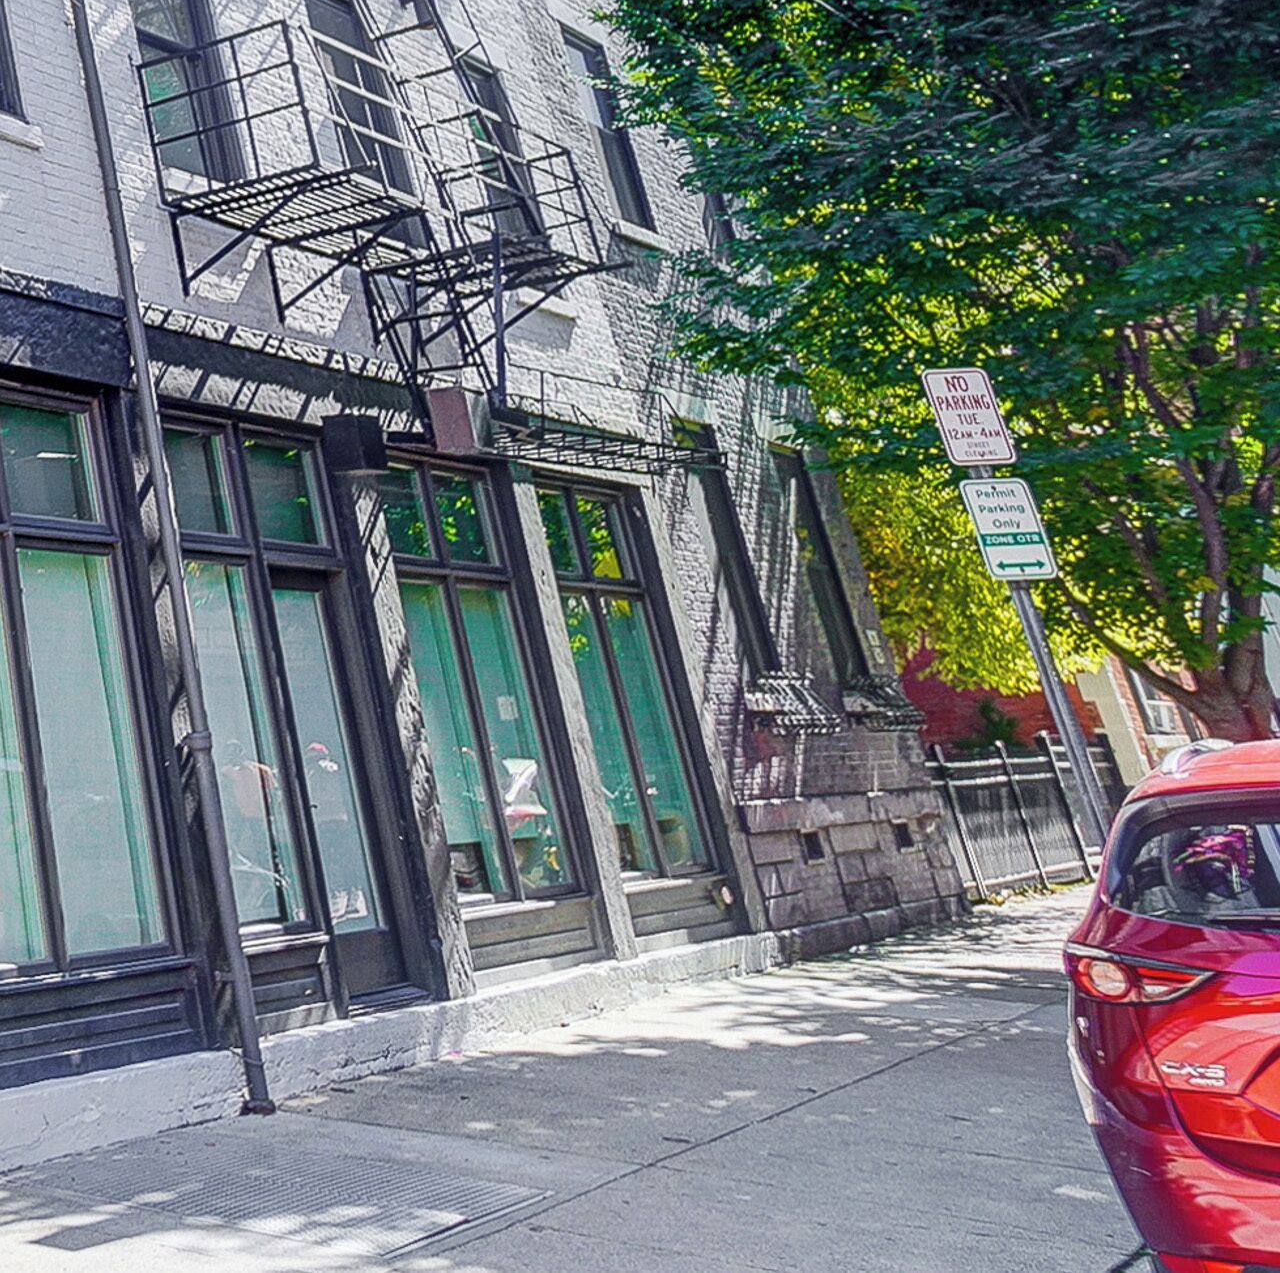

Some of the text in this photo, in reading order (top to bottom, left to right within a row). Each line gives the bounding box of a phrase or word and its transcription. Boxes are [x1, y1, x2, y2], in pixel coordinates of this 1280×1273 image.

[944, 375, 969, 393] NO
[936, 393, 991, 411] PARKING
[976, 488, 1017, 499] Permit
[978, 503, 1026, 514] Parking
[992, 518, 1021, 530] Only
[984, 535, 1016, 545] ZONE
